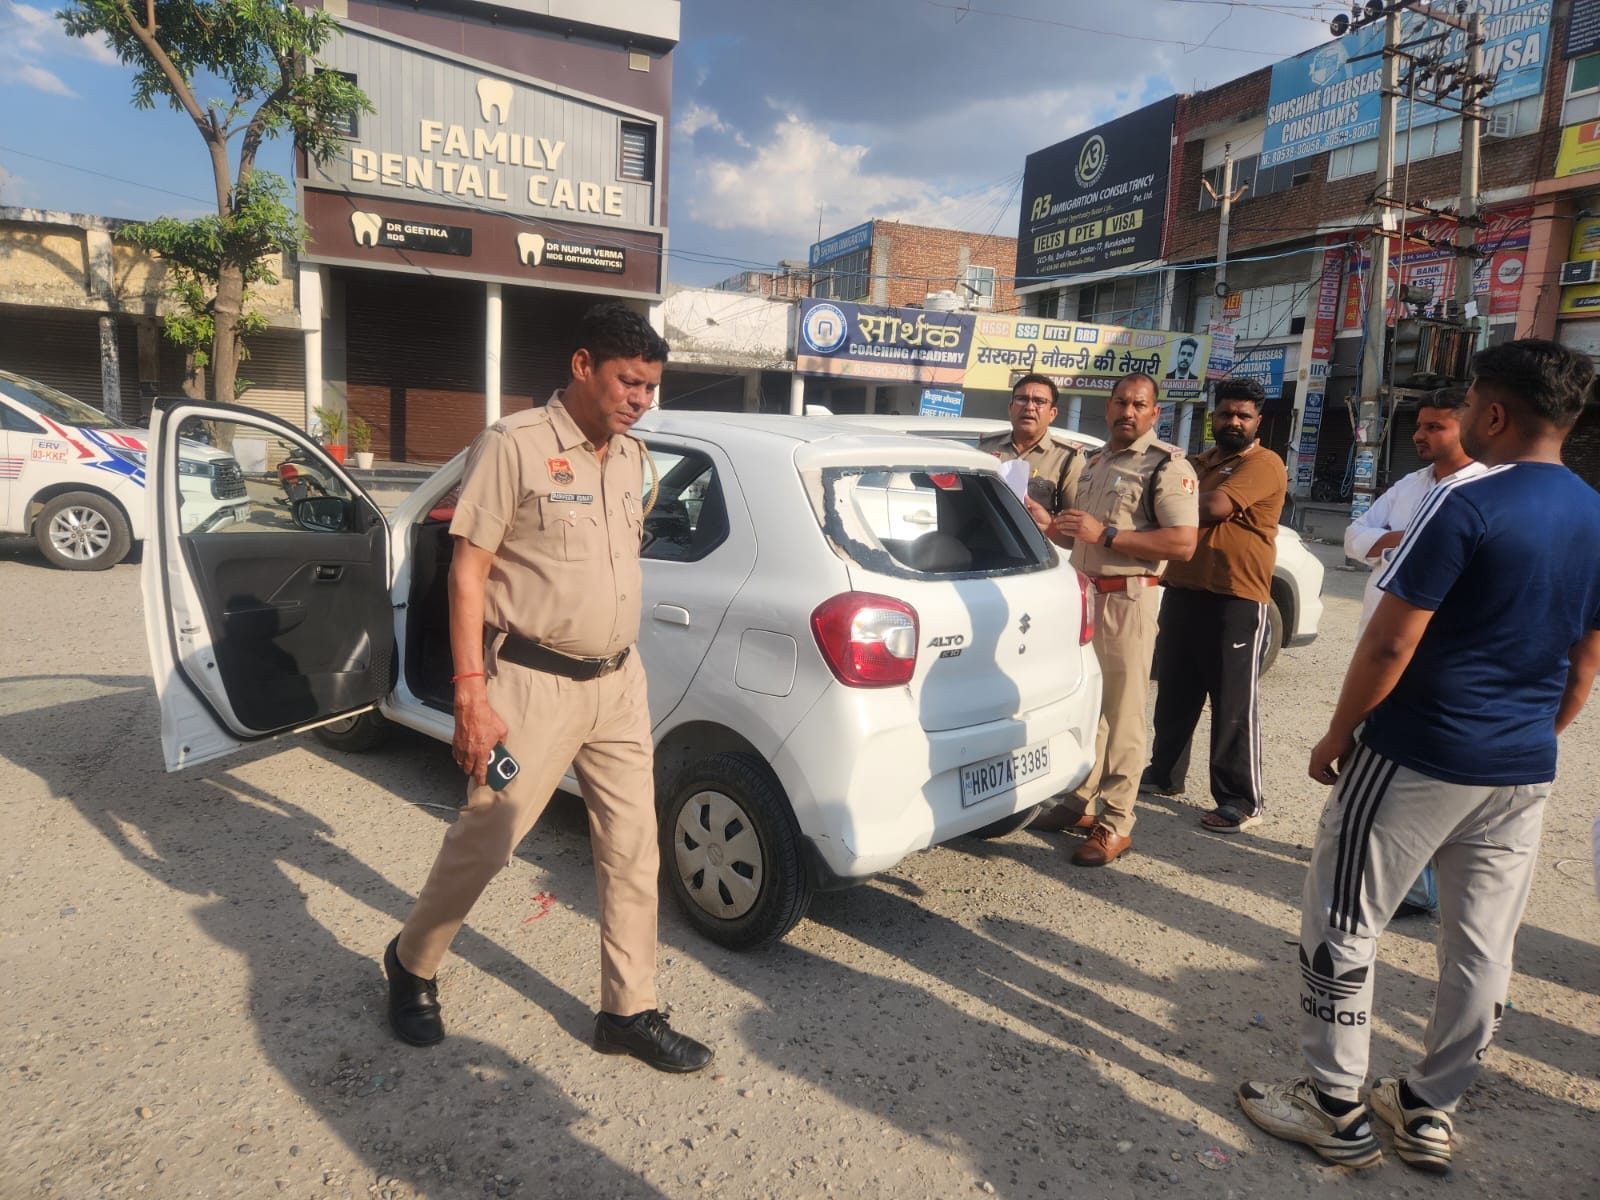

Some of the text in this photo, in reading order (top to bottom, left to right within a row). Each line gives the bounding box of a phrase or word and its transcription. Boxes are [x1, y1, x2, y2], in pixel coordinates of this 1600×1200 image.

[1267, 90, 1322, 126] SUNSHINE
[1322, 68, 1383, 108] OVERSEAS
[1281, 101, 1360, 144] CONSULTANTS
[421, 118, 566, 171] FAMILY
[351, 147, 625, 216] DENTAL CARE
[1031, 174, 1155, 222] A3 IMMIGRATION CONSULTANCY
[386, 222, 449, 238] DR GEETIKA
[1112, 212, 1136, 233] VISA
[1075, 224, 1096, 242] PTE
[1037, 234, 1061, 251] IELTS
[546, 243, 624, 260] DR NUPUR VERMA
[1416, 266, 1441, 276] BANK
[1418, 277, 1436, 286] SSC
[857, 312, 962, 349] सार्थक
[1017, 325, 1038, 338] SSC
[1045, 326, 1070, 340] HTET
[850, 343, 965, 364] COACHING ACADEMY
[977, 343, 1162, 375] सरकारी नौकरी की तैयारी
[1249, 348, 1283, 361] OVERSEAS
[1075, 377, 1115, 390] CLASSE
[38, 441, 60, 450] ERV
[926, 634, 965, 648] ALTO
[972, 745, 1049, 796] HR07AF3385
